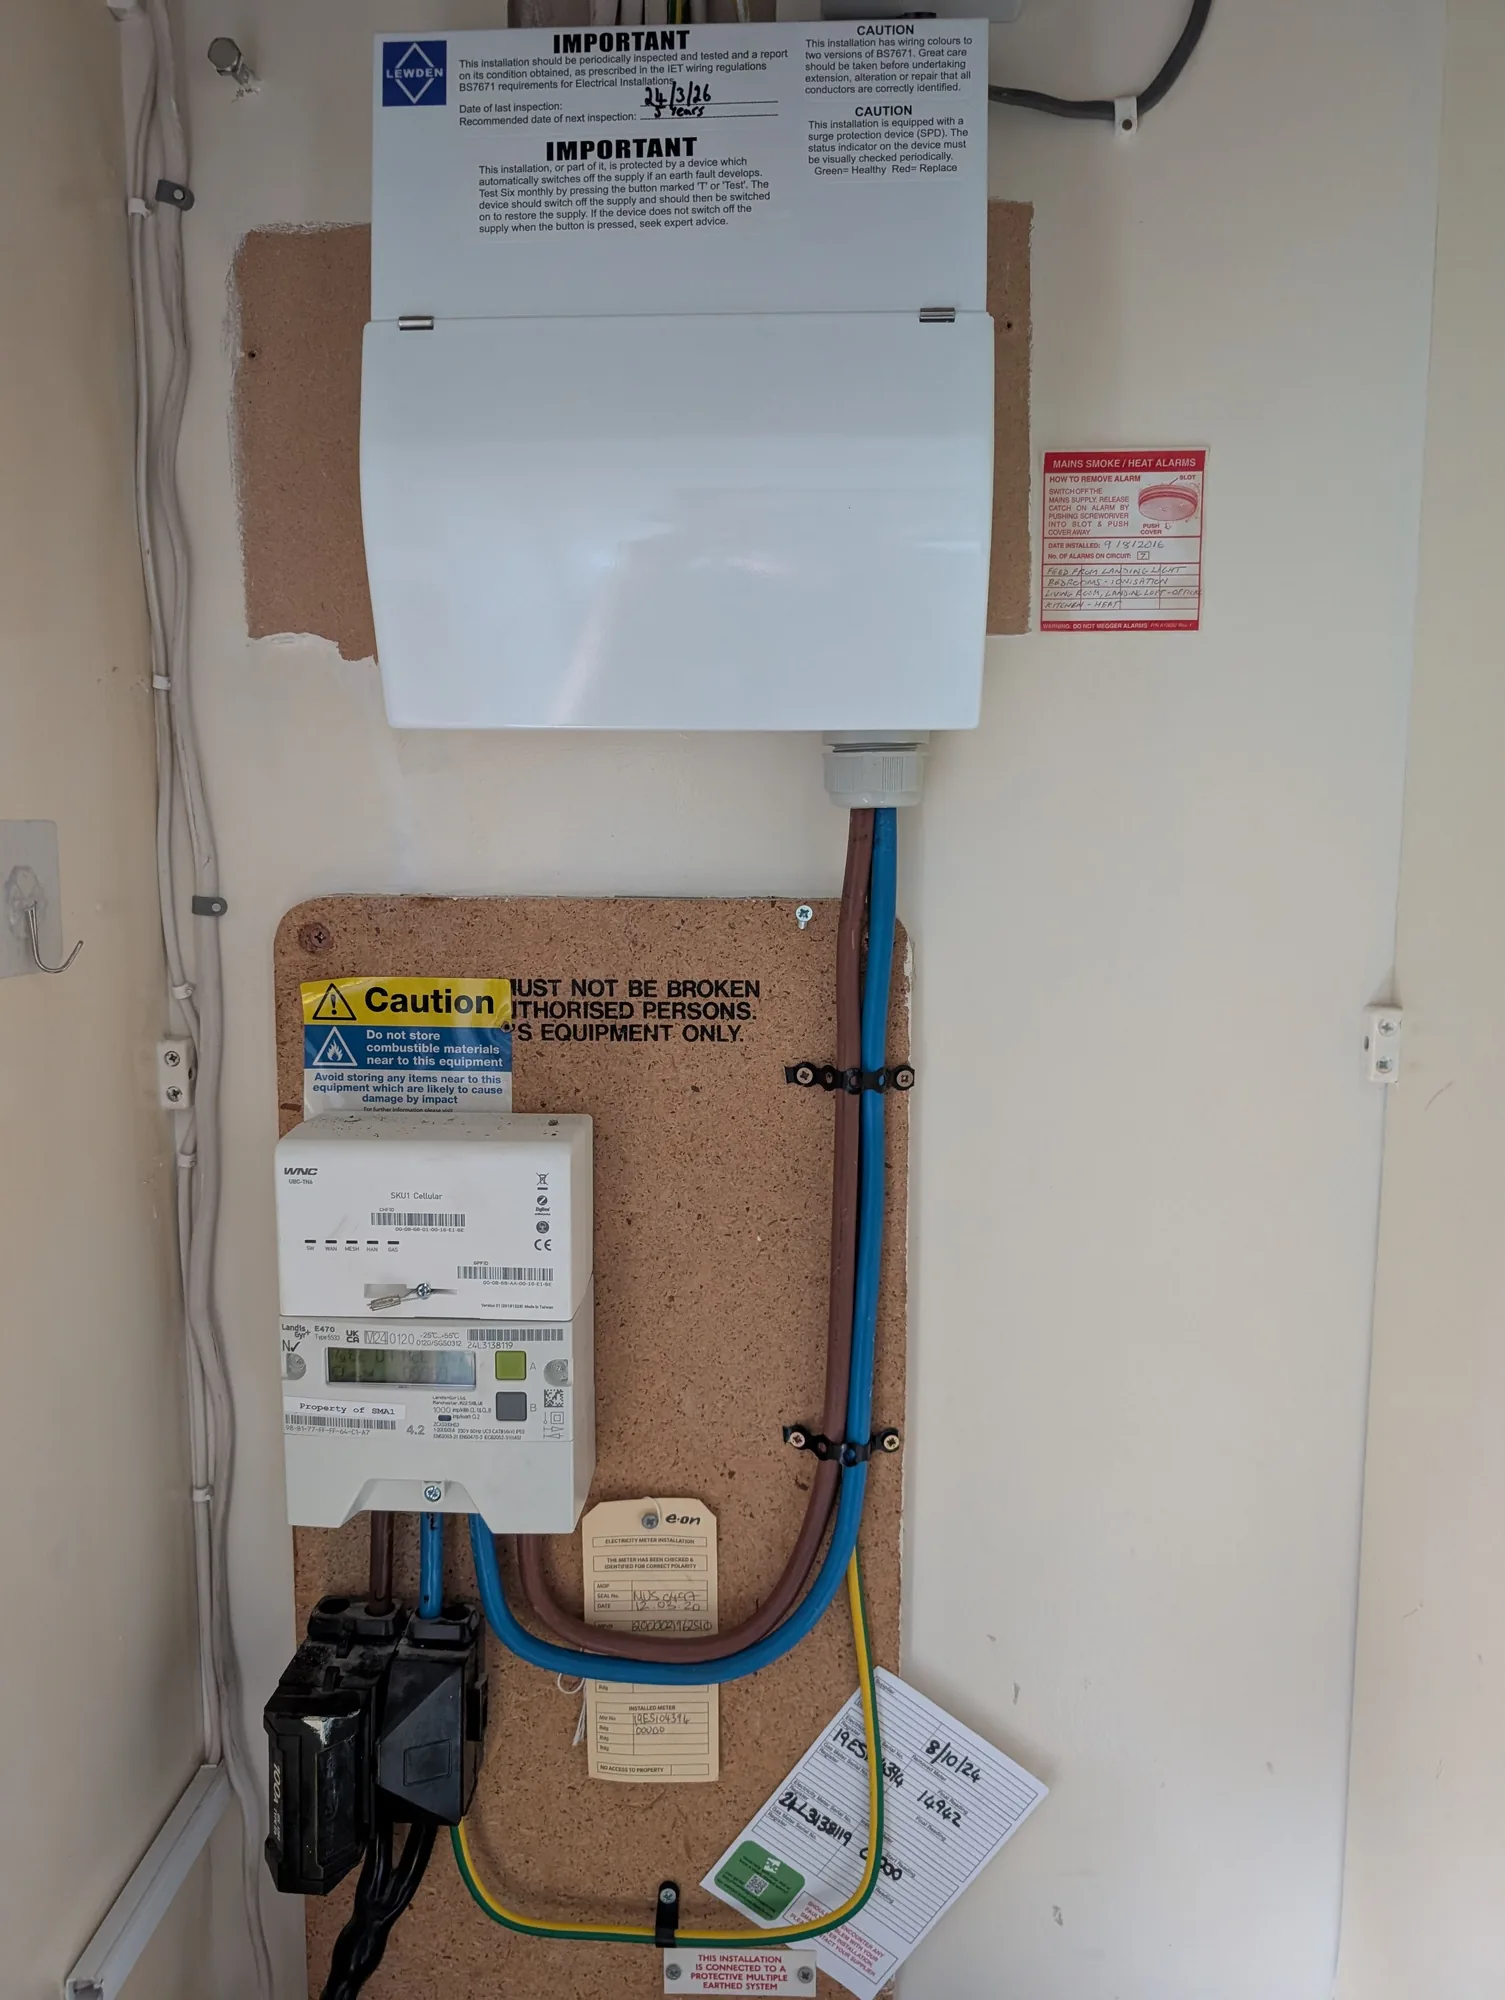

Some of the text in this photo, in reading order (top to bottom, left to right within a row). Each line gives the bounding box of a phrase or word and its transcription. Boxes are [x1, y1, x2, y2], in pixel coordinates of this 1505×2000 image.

[857, 25, 914, 36] CAUTION
[554, 30, 690, 54] IMPORTANT
[459, 60, 478, 68] This
[481, 58, 529, 67] installation
[532, 56, 562, 66] should
[565, 56, 576, 65] be
[580, 54, 631, 66] periodically
[633, 54, 678, 64] inspected
[680, 52, 697, 61] and
[700, 51, 729, 60] tested
[731, 50, 749, 59] and
[760, 49, 788, 60] report
[805, 59, 966, 71] should be taken before undertaking
[387, 68, 443, 78] LEWDEN
[459, 82, 494, 92] BS7671
[498, 80, 558, 92] requirements
[561, 80, 573, 88] for
[576, 77, 617, 87] Electrical
[805, 85, 855, 94] conductors
[875, 84, 914, 94] correctly
[917, 82, 961, 92] identified.
[645, 82, 712, 105] 24/3/26
[459, 102, 562, 113] Date of last inspection:
[855, 105, 912, 116] CAUTION
[460, 112, 636, 126] Recommended date of next inspection:
[808, 128, 968, 142] surge protection device (SPD). The
[547, 138, 697, 160] IMPORTANT
[814, 164, 957, 175] Green= Healthy Red= Replace
[479, 217, 728, 234] supply when the button is pressed, seek expert advice.
[1053, 460, 1083, 468] MAINS
[1086, 460, 1121, 468] SMOKE
[1128, 459, 1153, 467] HEAT
[1155, 458, 1196, 466] ALARMS
[571, 979, 618, 997] NOT
[629, 979, 657, 998] BE
[667, 979, 760, 999] BROKEN
[366, 987, 494, 1014] Caution
[643, 1002, 757, 1020] PERSONS.
[366, 1030, 440, 1040] Do not store
[541, 1023, 670, 1042] EQUIPMENT
[682, 1025, 744, 1042] ONLY.
[366, 1043, 500, 1054] combustible materials
[366, 1056, 503, 1068] near to this equipment
[315, 1072, 344, 1081] Avoid
[347, 1073, 384, 1083] storing
[387, 1075, 406, 1083] any
[409, 1074, 438, 1083] items
[468, 1075, 478, 1083] to
[482, 1075, 501, 1084] this
[313, 1083, 370, 1093] equipment
[373, 1084, 404, 1092] which
[427, 1085, 455, 1095] likely
[458, 1086, 468, 1094] to
[362, 1094, 458, 1105] damage by impact
[390, 1333, 415, 1345] 0120
[530, 1362, 536, 1370] A
[300, 1403, 347, 1413] Property
[530, 1404, 537, 1412] B
[406, 1425, 425, 1435] 4.2
[926, 1740, 980, 1783] 8/10/24
[917, 1790, 961, 1828] 14942
[719, 1955, 781, 1963] INSTALLATION
[705, 1964, 761, 1972] CONNECTED
[690, 1973, 788, 1982] PROTECTIVE MULTIPLE
